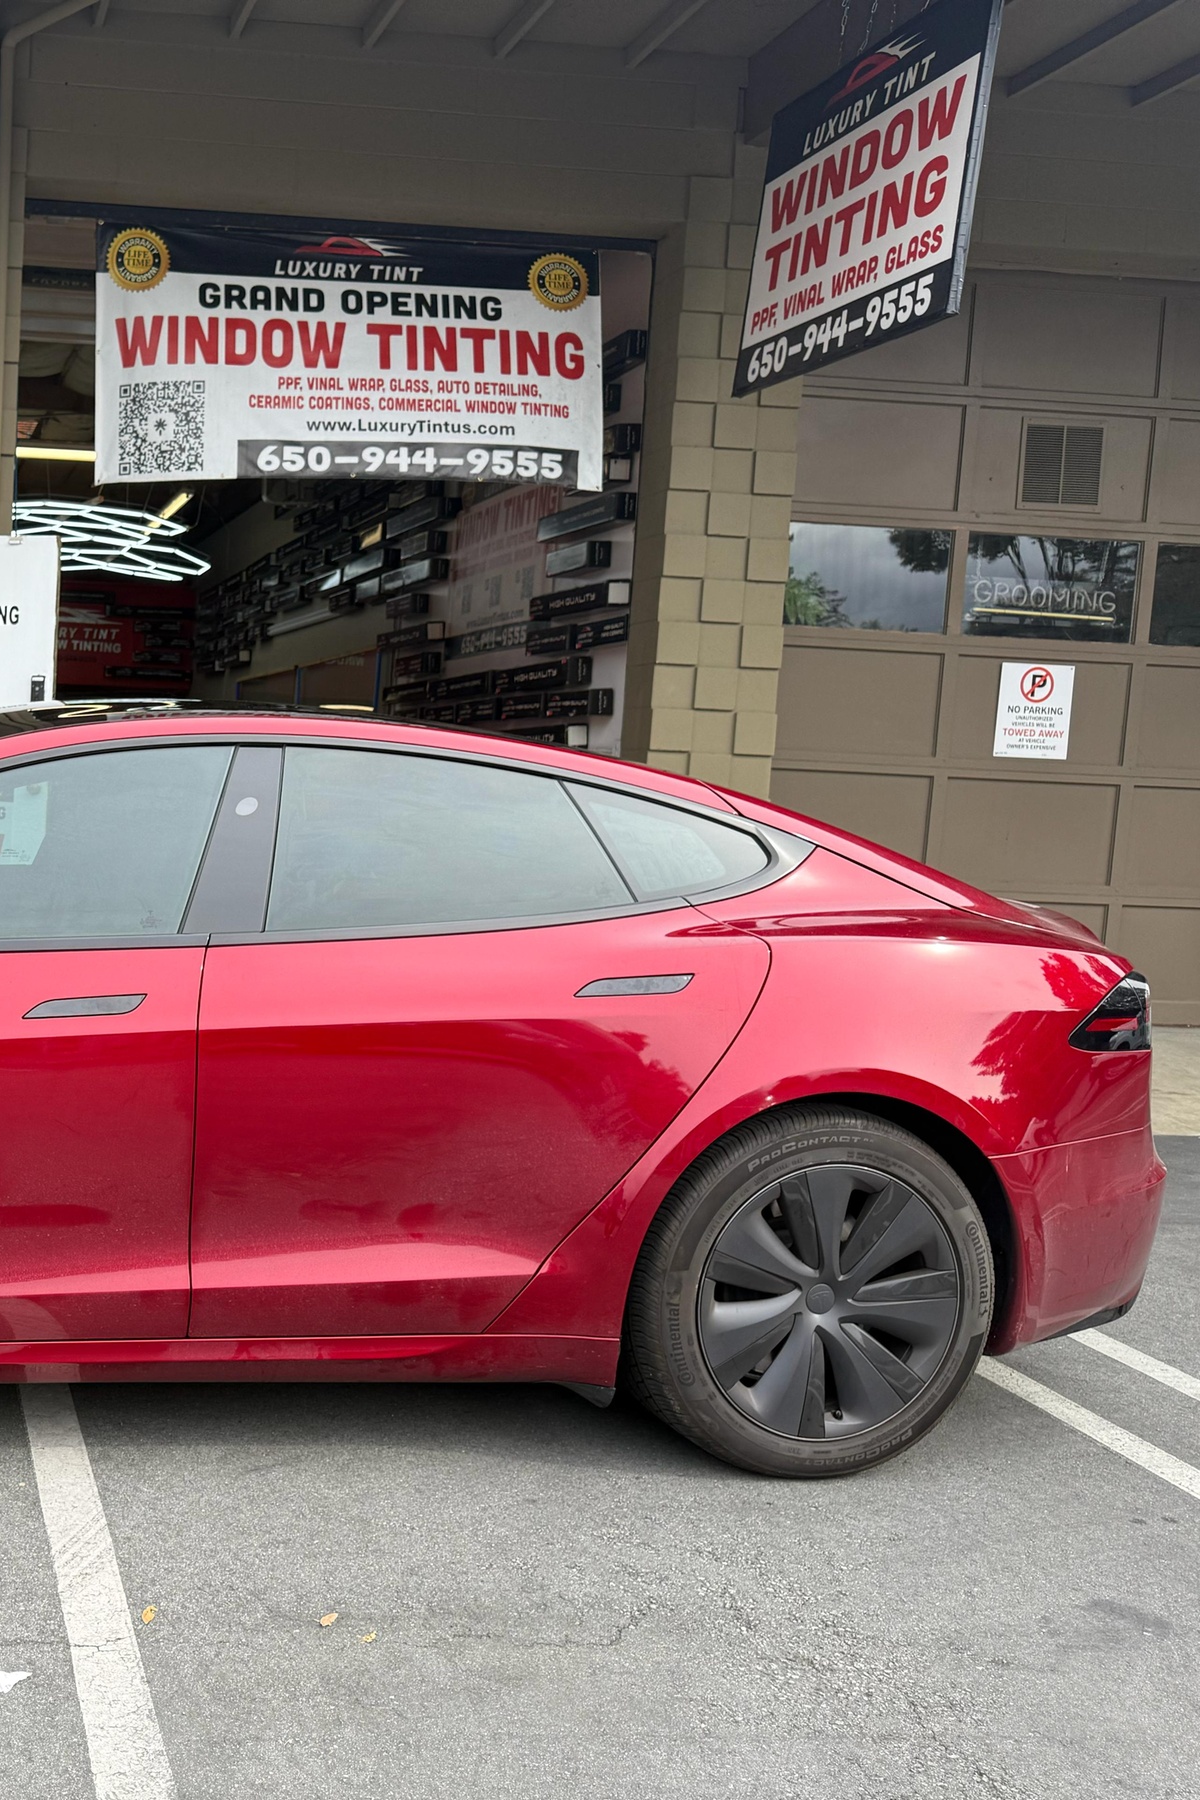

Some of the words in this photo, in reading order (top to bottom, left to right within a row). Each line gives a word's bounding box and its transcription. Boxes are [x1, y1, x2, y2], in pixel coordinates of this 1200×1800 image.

[802, 89, 877, 157] LUXURY
[884, 51, 936, 105] TINT
[771, 74, 967, 233] WINDOW
[765, 155, 949, 292] TINTING
[118, 238, 159, 254] WARRANTY
[127, 250, 150, 258] LIFE
[125, 258, 152, 267] TIME
[274, 259, 362, 279] LUXURY
[369, 265, 424, 282] TINT
[539, 263, 578, 278] WARRANTY
[546, 281, 572, 289] TIME
[751, 303, 778, 335] PPF,
[783, 281, 825, 320] VINAL
[831, 255, 879, 298] WRAP,
[884, 224, 944, 274] GLASS
[198, 282, 325, 313] GRAND
[340, 288, 502, 321] OPENING
[746, 272, 934, 383] 650-944-9555
[115, 315, 347, 369] WINDOW
[366, 323, 585, 380] TINTING
[277, 376, 303, 391] PPF,
[307, 377, 344, 390] VINAL
[348, 377, 386, 393] WRAP,
[389, 378, 433, 395] GLASS,
[437, 380, 470, 394] AUTO
[474, 382, 542, 399] DETAILING,
[249, 394, 304, 409] CERAMIC
[308, 396, 375, 412] COATINGS,
[378, 397, 461, 413] COMMERCIAL
[465, 400, 517, 415] WINDOW
[521, 402, 570, 419] TINTING
[306, 418, 516, 436] www.LuxuryTintus.com
[257, 445, 563, 479] 650-944-9555
[974, 580, 1116, 613] GROOMING
[84, 628, 120, 640] TINT
[71, 640, 122, 653] TINTING
[1007, 705, 1021, 714] NO
[1023, 706, 1064, 716] PARKING
[1002, 728, 1036, 737] TOWED
[1038, 729, 1065, 739] AWAY
[965, 1220, 990, 1304] Continental
